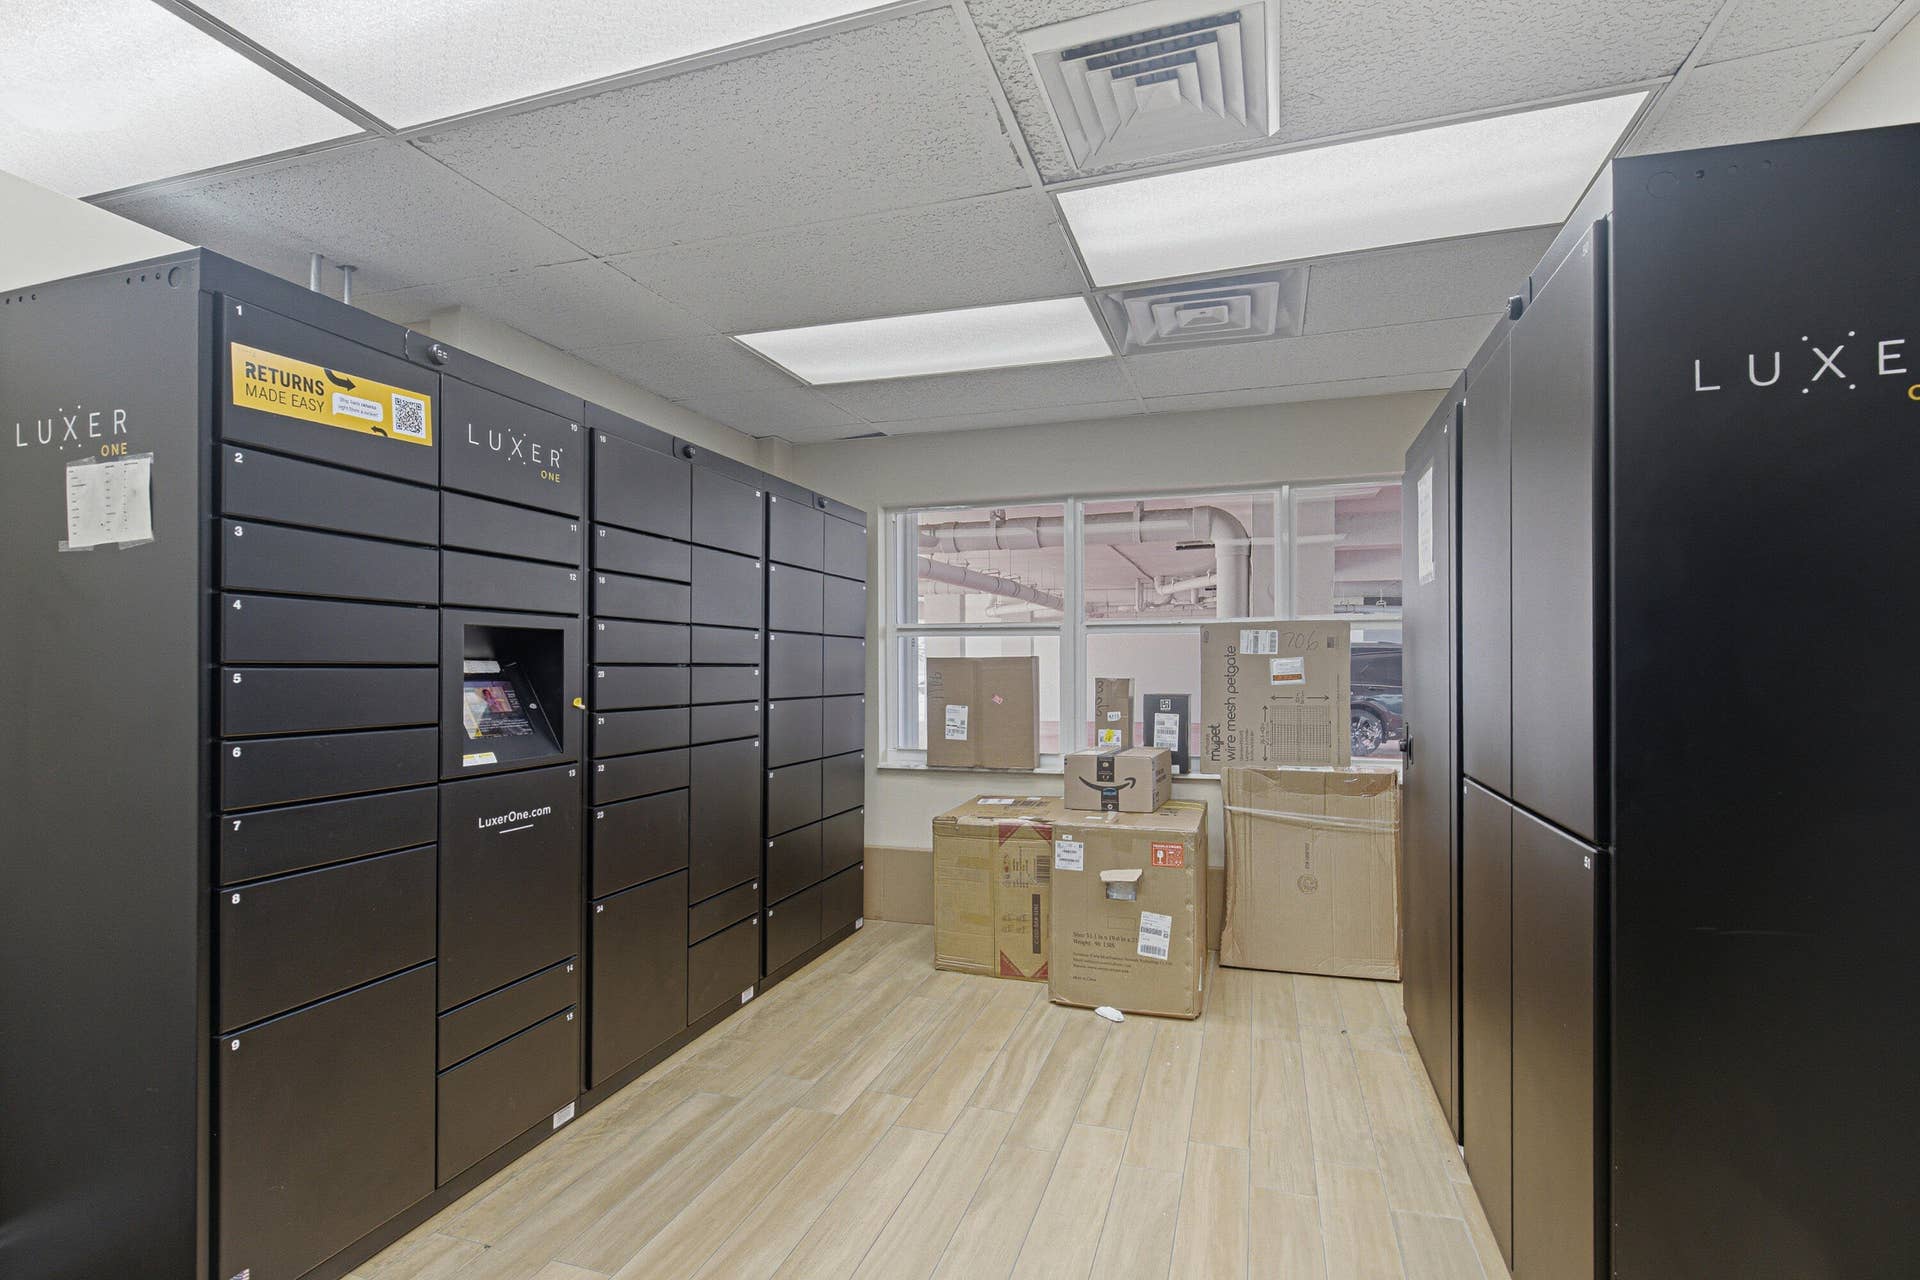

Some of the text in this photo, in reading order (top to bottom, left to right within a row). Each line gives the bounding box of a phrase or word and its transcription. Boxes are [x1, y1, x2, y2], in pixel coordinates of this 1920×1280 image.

[234, 304, 243, 317] 1
[245, 361, 325, 397] RETURNS
[245, 383, 287, 406] MADE
[291, 394, 325, 414] EASY
[16, 405, 127, 449] LUXER
[570, 423, 579, 433] 10
[101, 443, 128, 456] ONE
[468, 424, 561, 468] LUXER
[233, 451, 244, 464] 2
[540, 470, 561, 483] ONE
[233, 524, 244, 538] 3
[570, 523, 577, 533] 11
[569, 572, 578, 582] 12
[232, 598, 243, 611] 4
[231, 672, 243, 685] 5
[1224, 696, 1237, 732] mesh
[231, 745, 243, 759] 6
[1225, 735, 1237, 761] wire
[478, 805, 551, 829] LuxerOne.com
[232, 819, 242, 832] 7
[231, 892, 242, 906] 8
[230, 1038, 241, 1052] 9
